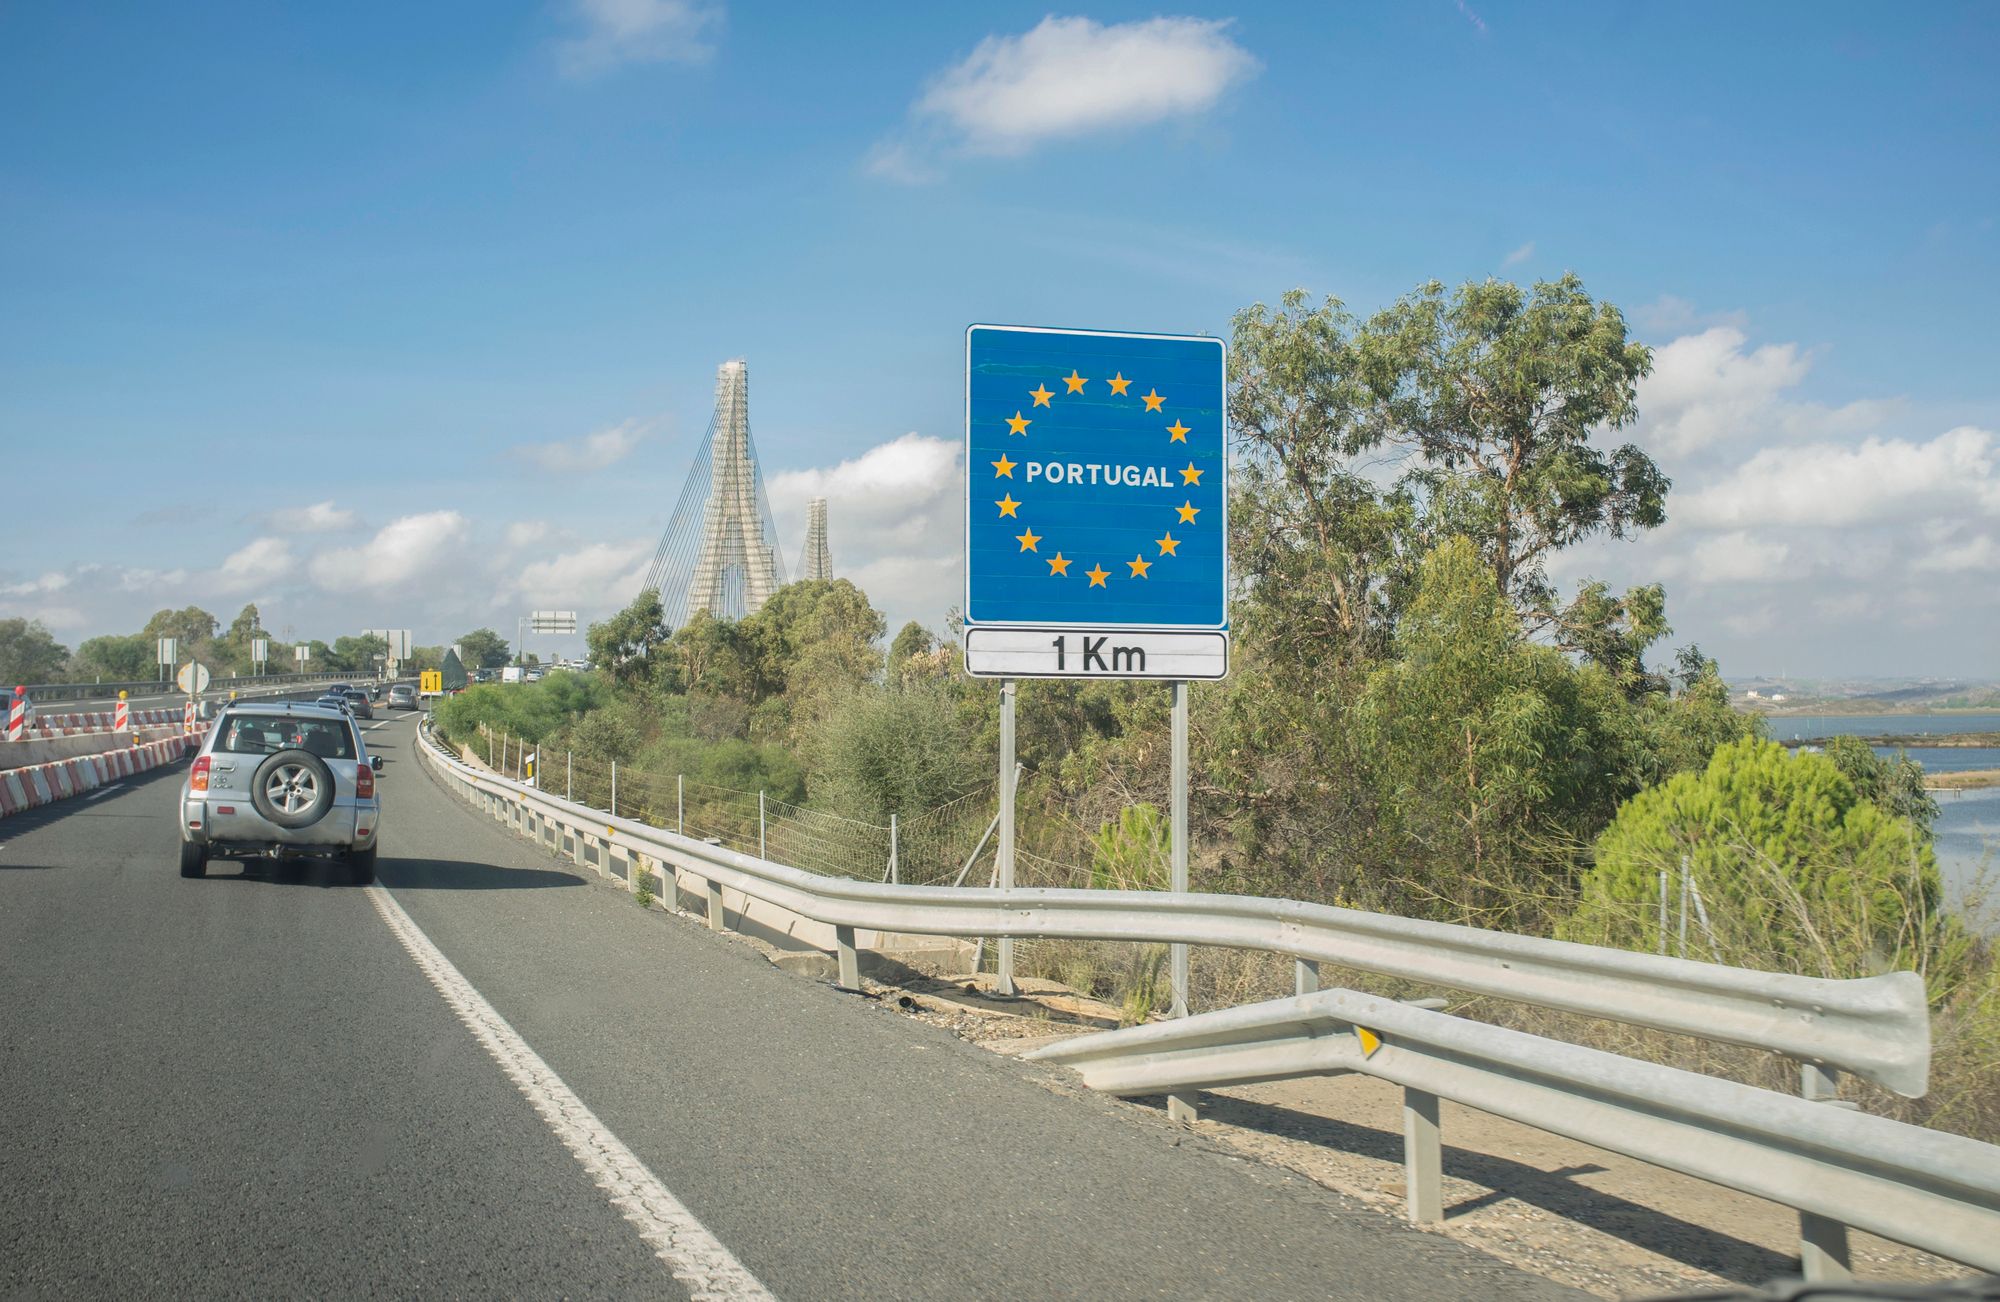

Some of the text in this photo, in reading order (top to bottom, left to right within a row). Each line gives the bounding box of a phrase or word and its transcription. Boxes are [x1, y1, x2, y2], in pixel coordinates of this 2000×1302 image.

[1026, 461, 1174, 488] PORTUGAL
[1052, 635, 1146, 672] 1 Km
